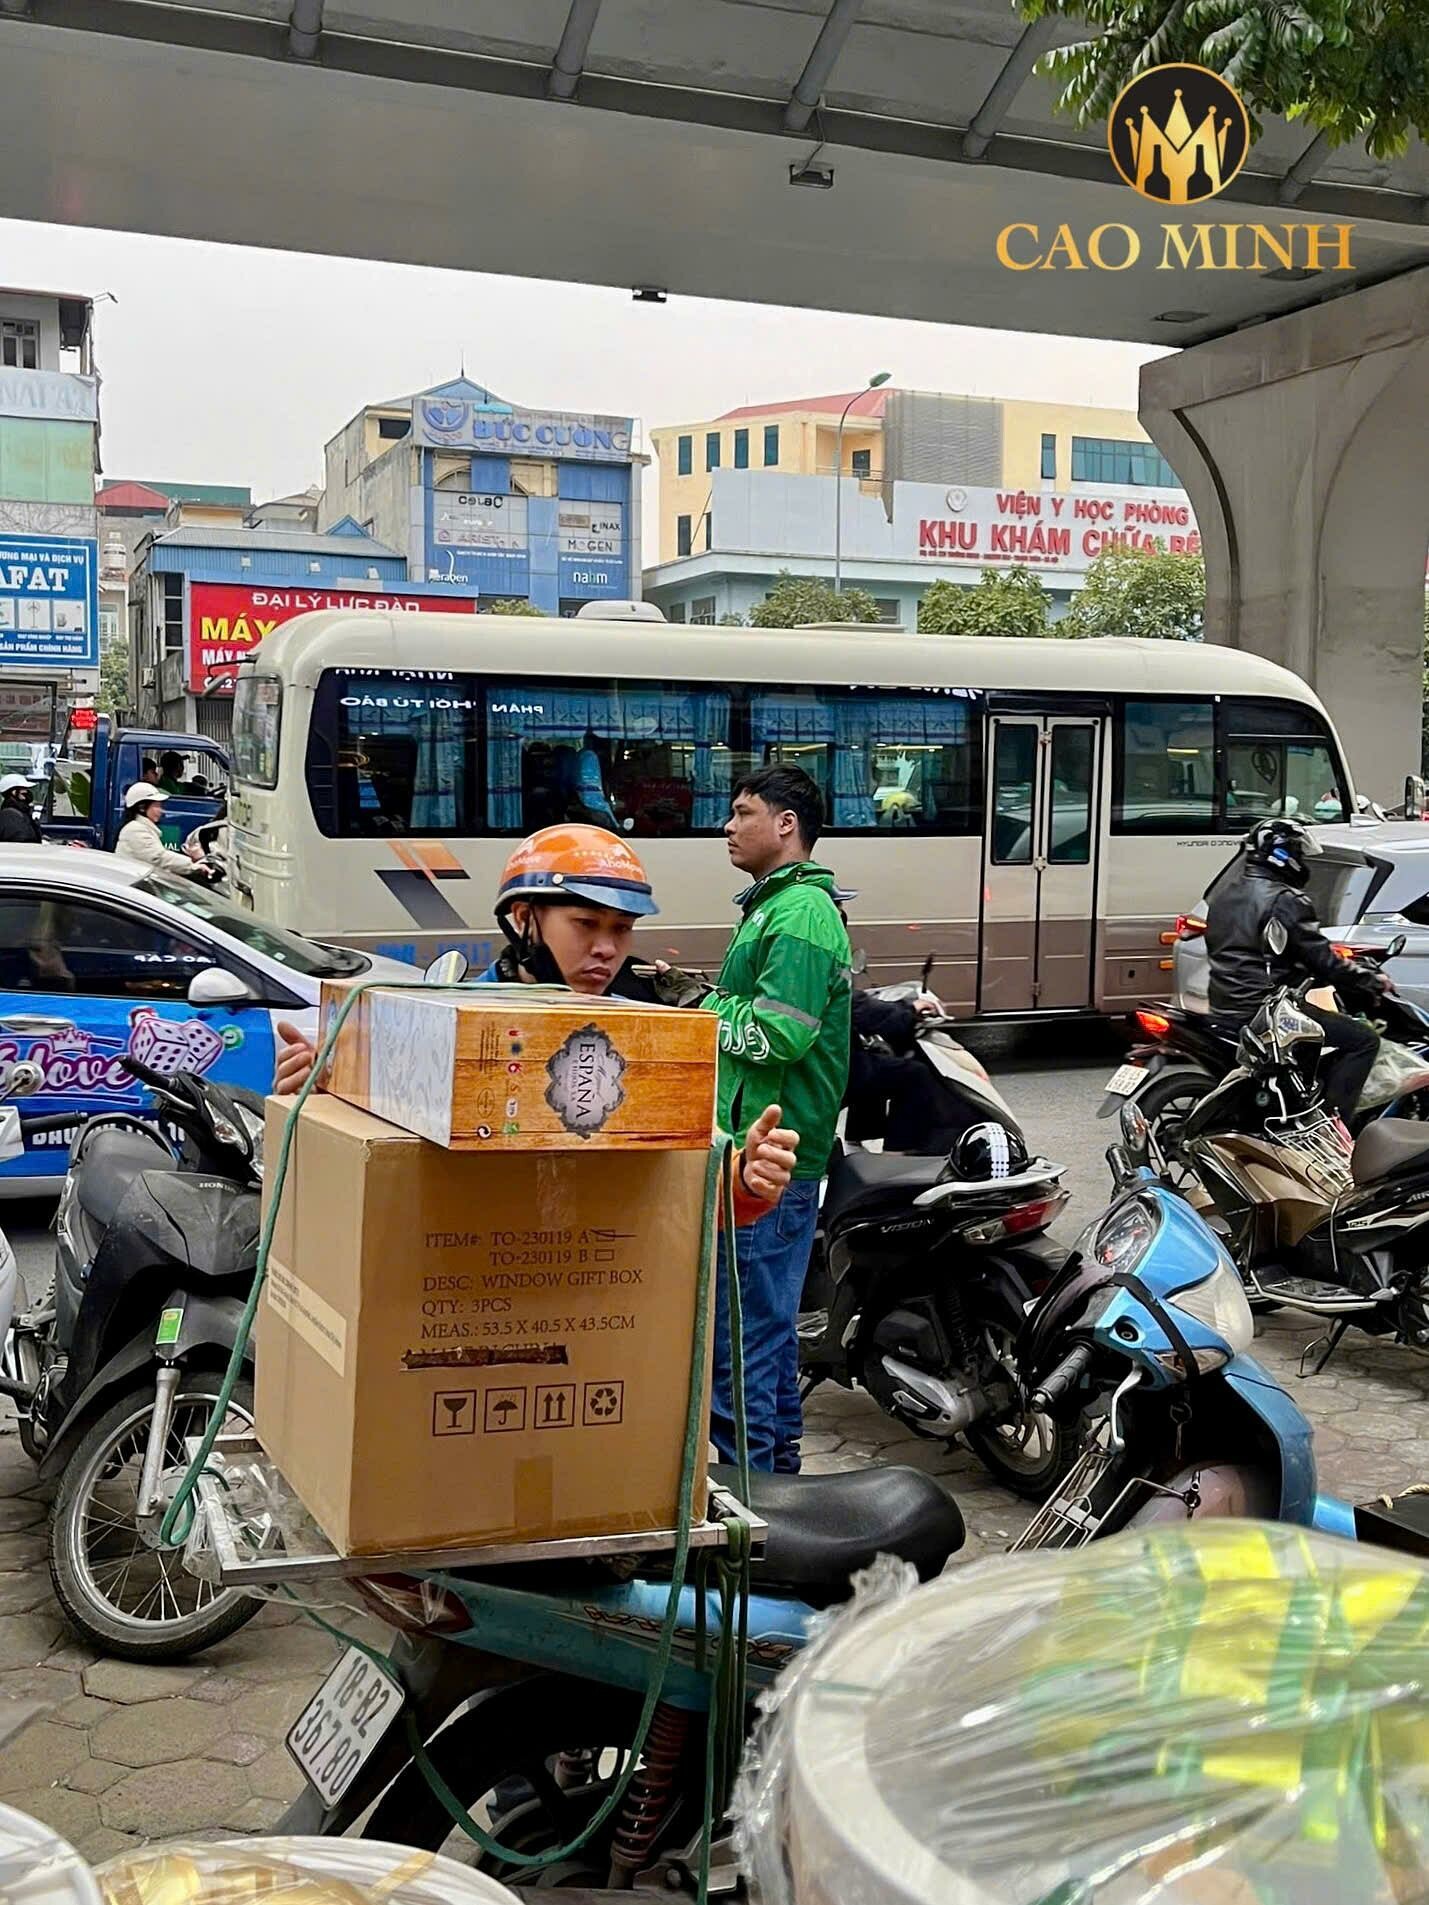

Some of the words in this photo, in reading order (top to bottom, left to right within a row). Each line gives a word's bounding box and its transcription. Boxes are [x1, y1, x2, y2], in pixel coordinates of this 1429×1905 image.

[997, 491, 1040, 520] VIỆN
[1052, 498, 1063, 516] Y
[1074, 500, 1113, 525] HỌC
[1125, 500, 1189, 526] PHÒNG
[919, 519, 978, 549] KHU
[991, 520, 1071, 556] KHÁM
[253, 593, 289, 610] ĐẠI
[295, 593, 321, 609] LÝ
[576, 1043, 596, 1118] ESPAÑA
[425, 1232, 481, 1248] ITEM#
[490, 1231, 572, 1247] TO-230119
[578, 1231, 590, 1244] A
[489, 1250, 572, 1266] TO-230119
[578, 1250, 588, 1262] B
[481, 1272, 563, 1289] WINDOW
[567, 1270, 607, 1286] GIFT
[610, 1269, 643, 1284] BOX
[421, 1300, 464, 1317] QTY:
[472, 1297, 512, 1313] 3PCS
[421, 1323, 478, 1339] MEAS.:
[482, 1321, 512, 1336] 53.5
[516, 1320, 529, 1334] X
[531, 1319, 561, 1333] 40.5
[564, 1317, 577, 1332] X
[579, 1315, 636, 1331] 43.5CM
[294, 1699, 362, 1797] 367.80
